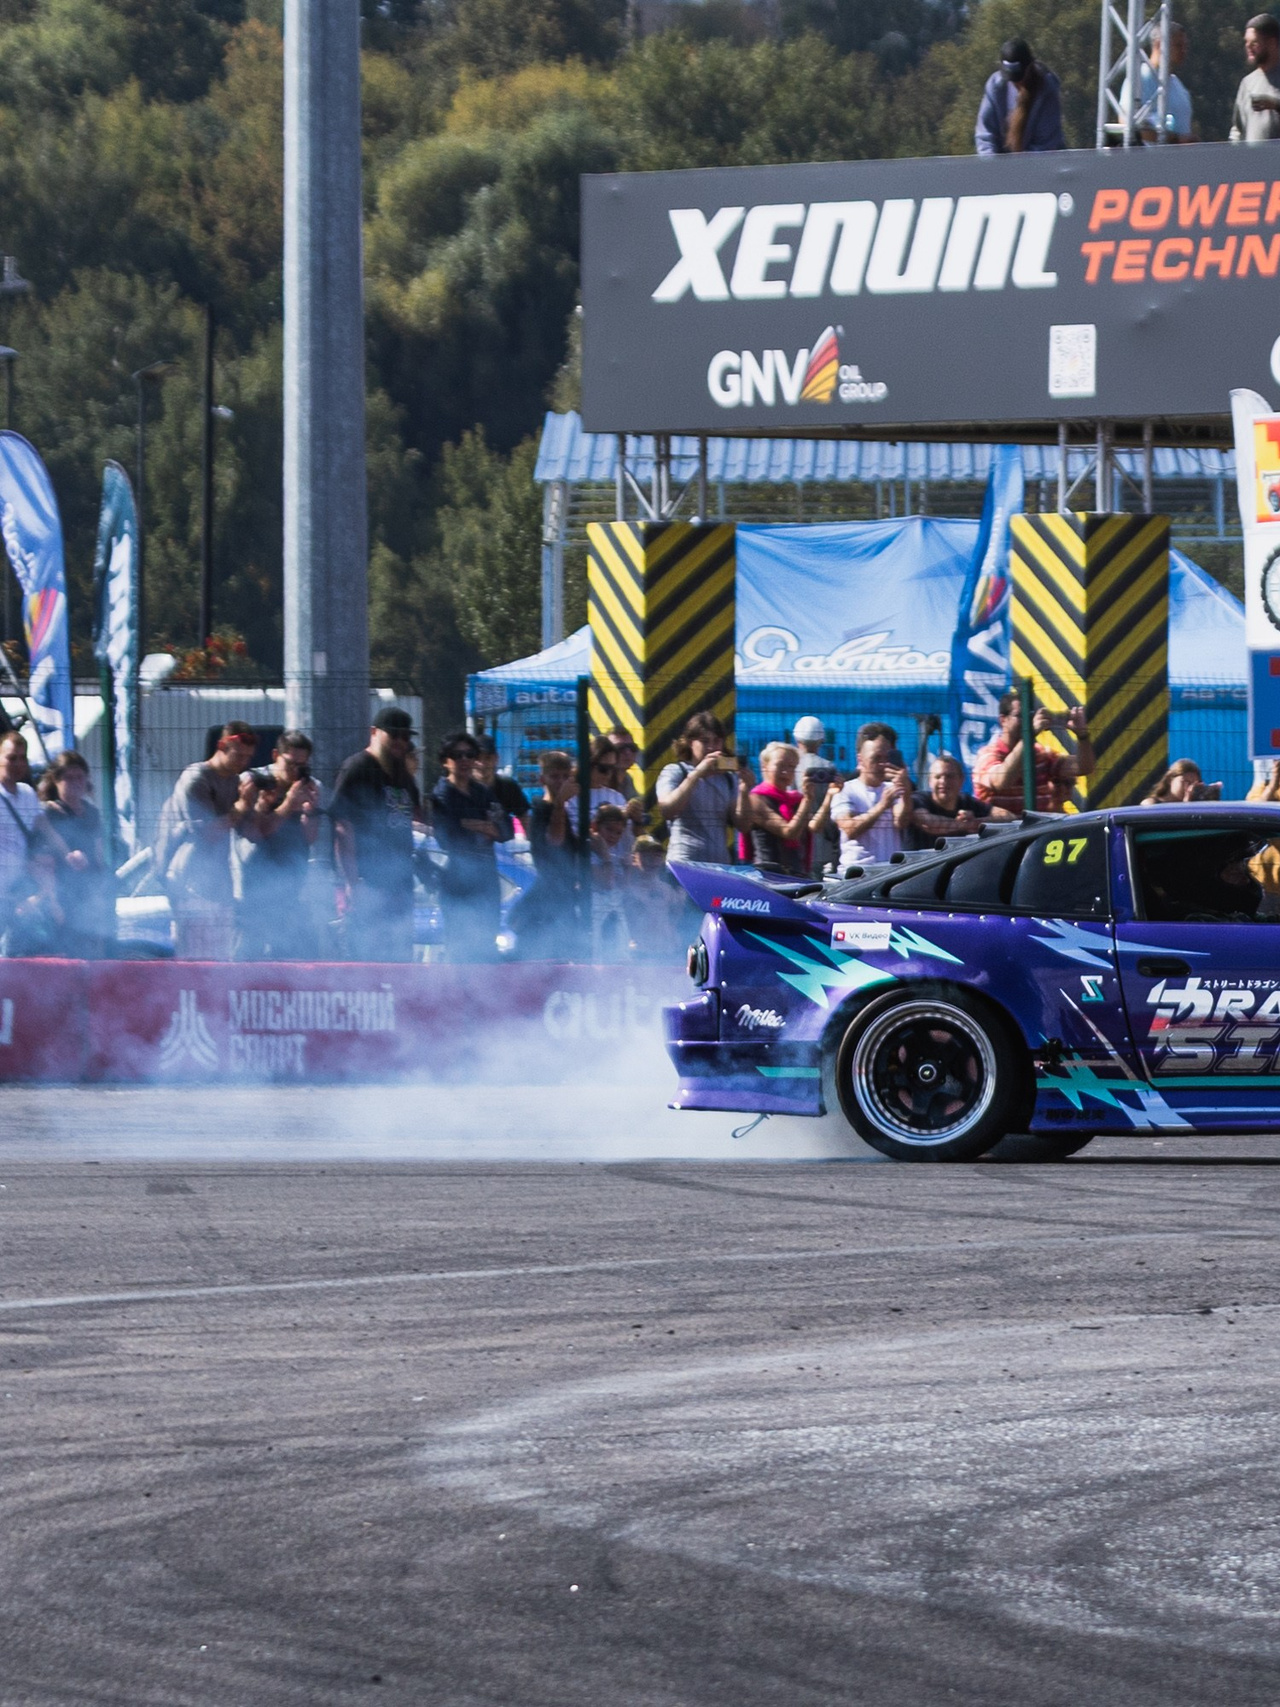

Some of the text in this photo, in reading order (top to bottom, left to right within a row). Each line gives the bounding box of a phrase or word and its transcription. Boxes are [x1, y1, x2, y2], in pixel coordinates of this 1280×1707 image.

[652, 192, 1058, 303] XENUM
[707, 347, 809, 408] GNV
[838, 363, 863, 383] OIL
[838, 380, 887, 403] GROUP
[1044, 838, 1088, 864] 97
[850, 932, 889, 942] VK Видео
[228, 983, 395, 1031] МОСКОВСКИЙ
[229, 1032, 306, 1075] СПОРТ
